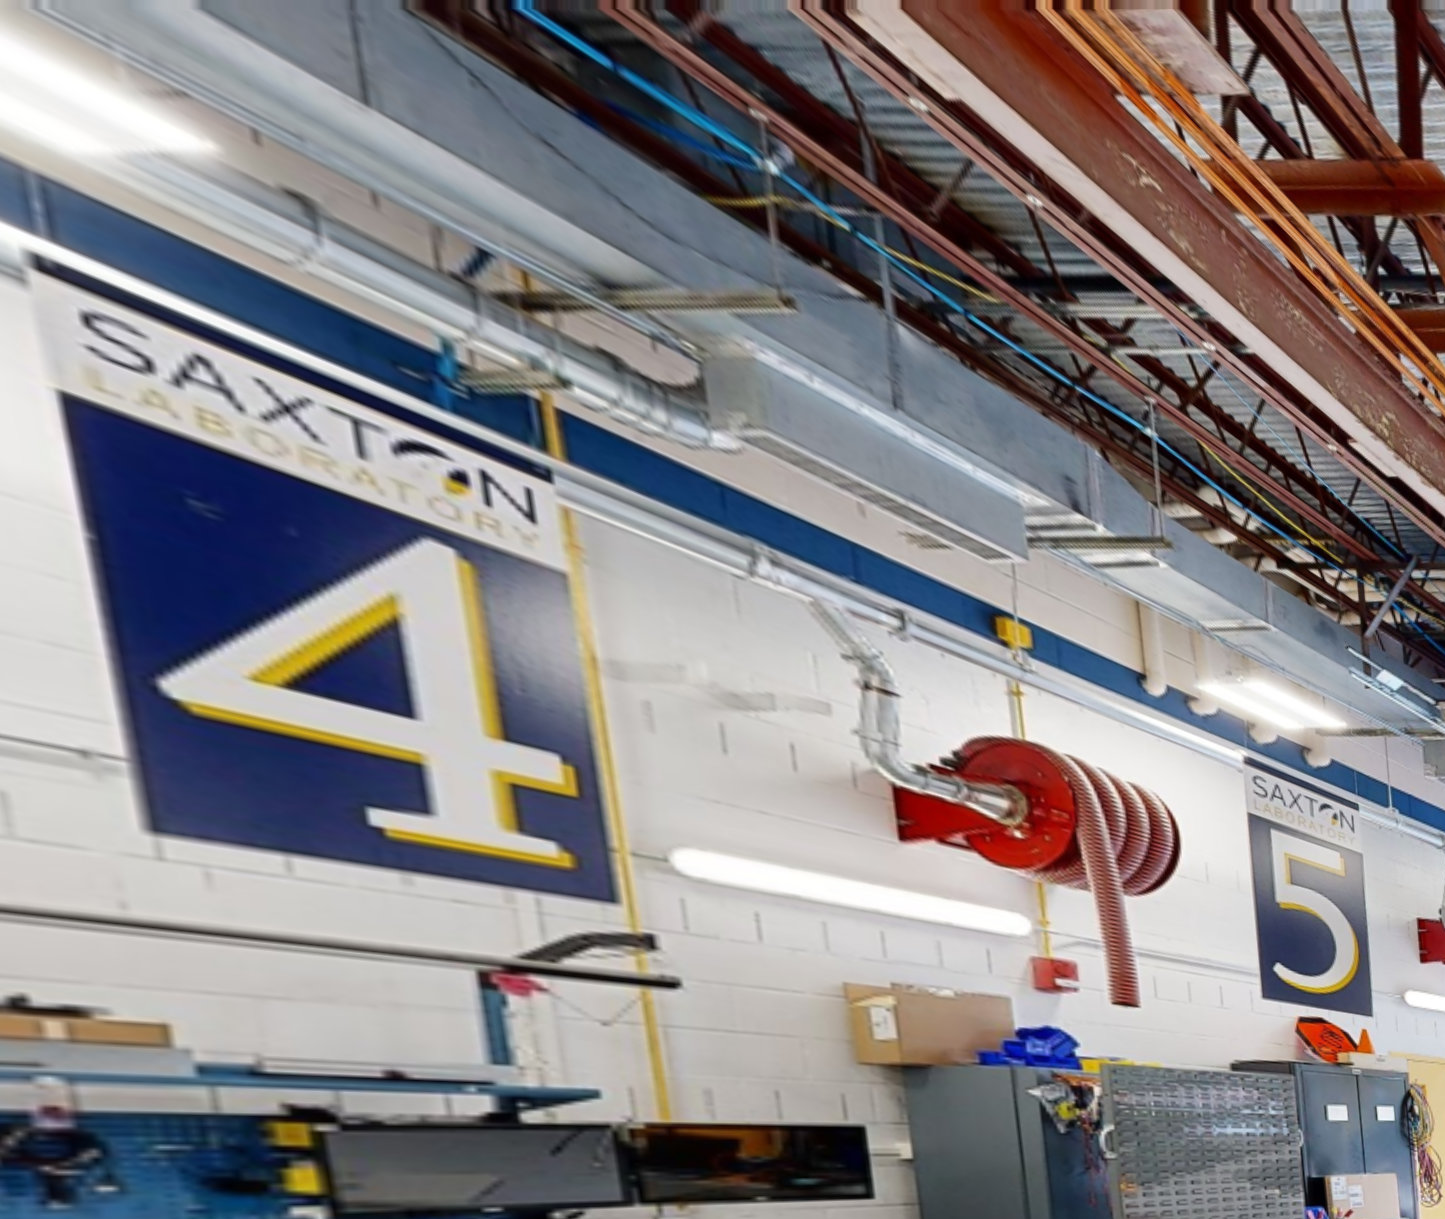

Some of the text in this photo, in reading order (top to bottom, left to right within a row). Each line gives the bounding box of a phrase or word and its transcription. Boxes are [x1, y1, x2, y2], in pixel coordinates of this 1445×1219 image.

[78, 309, 538, 526] SAXTON
[81, 366, 541, 551] LABORATORY
[154, 537, 578, 868] 4
[1252, 774, 1356, 834] SAXTON
[1253, 802, 1356, 846] LABORATORY
[1271, 828, 1360, 995] 5
